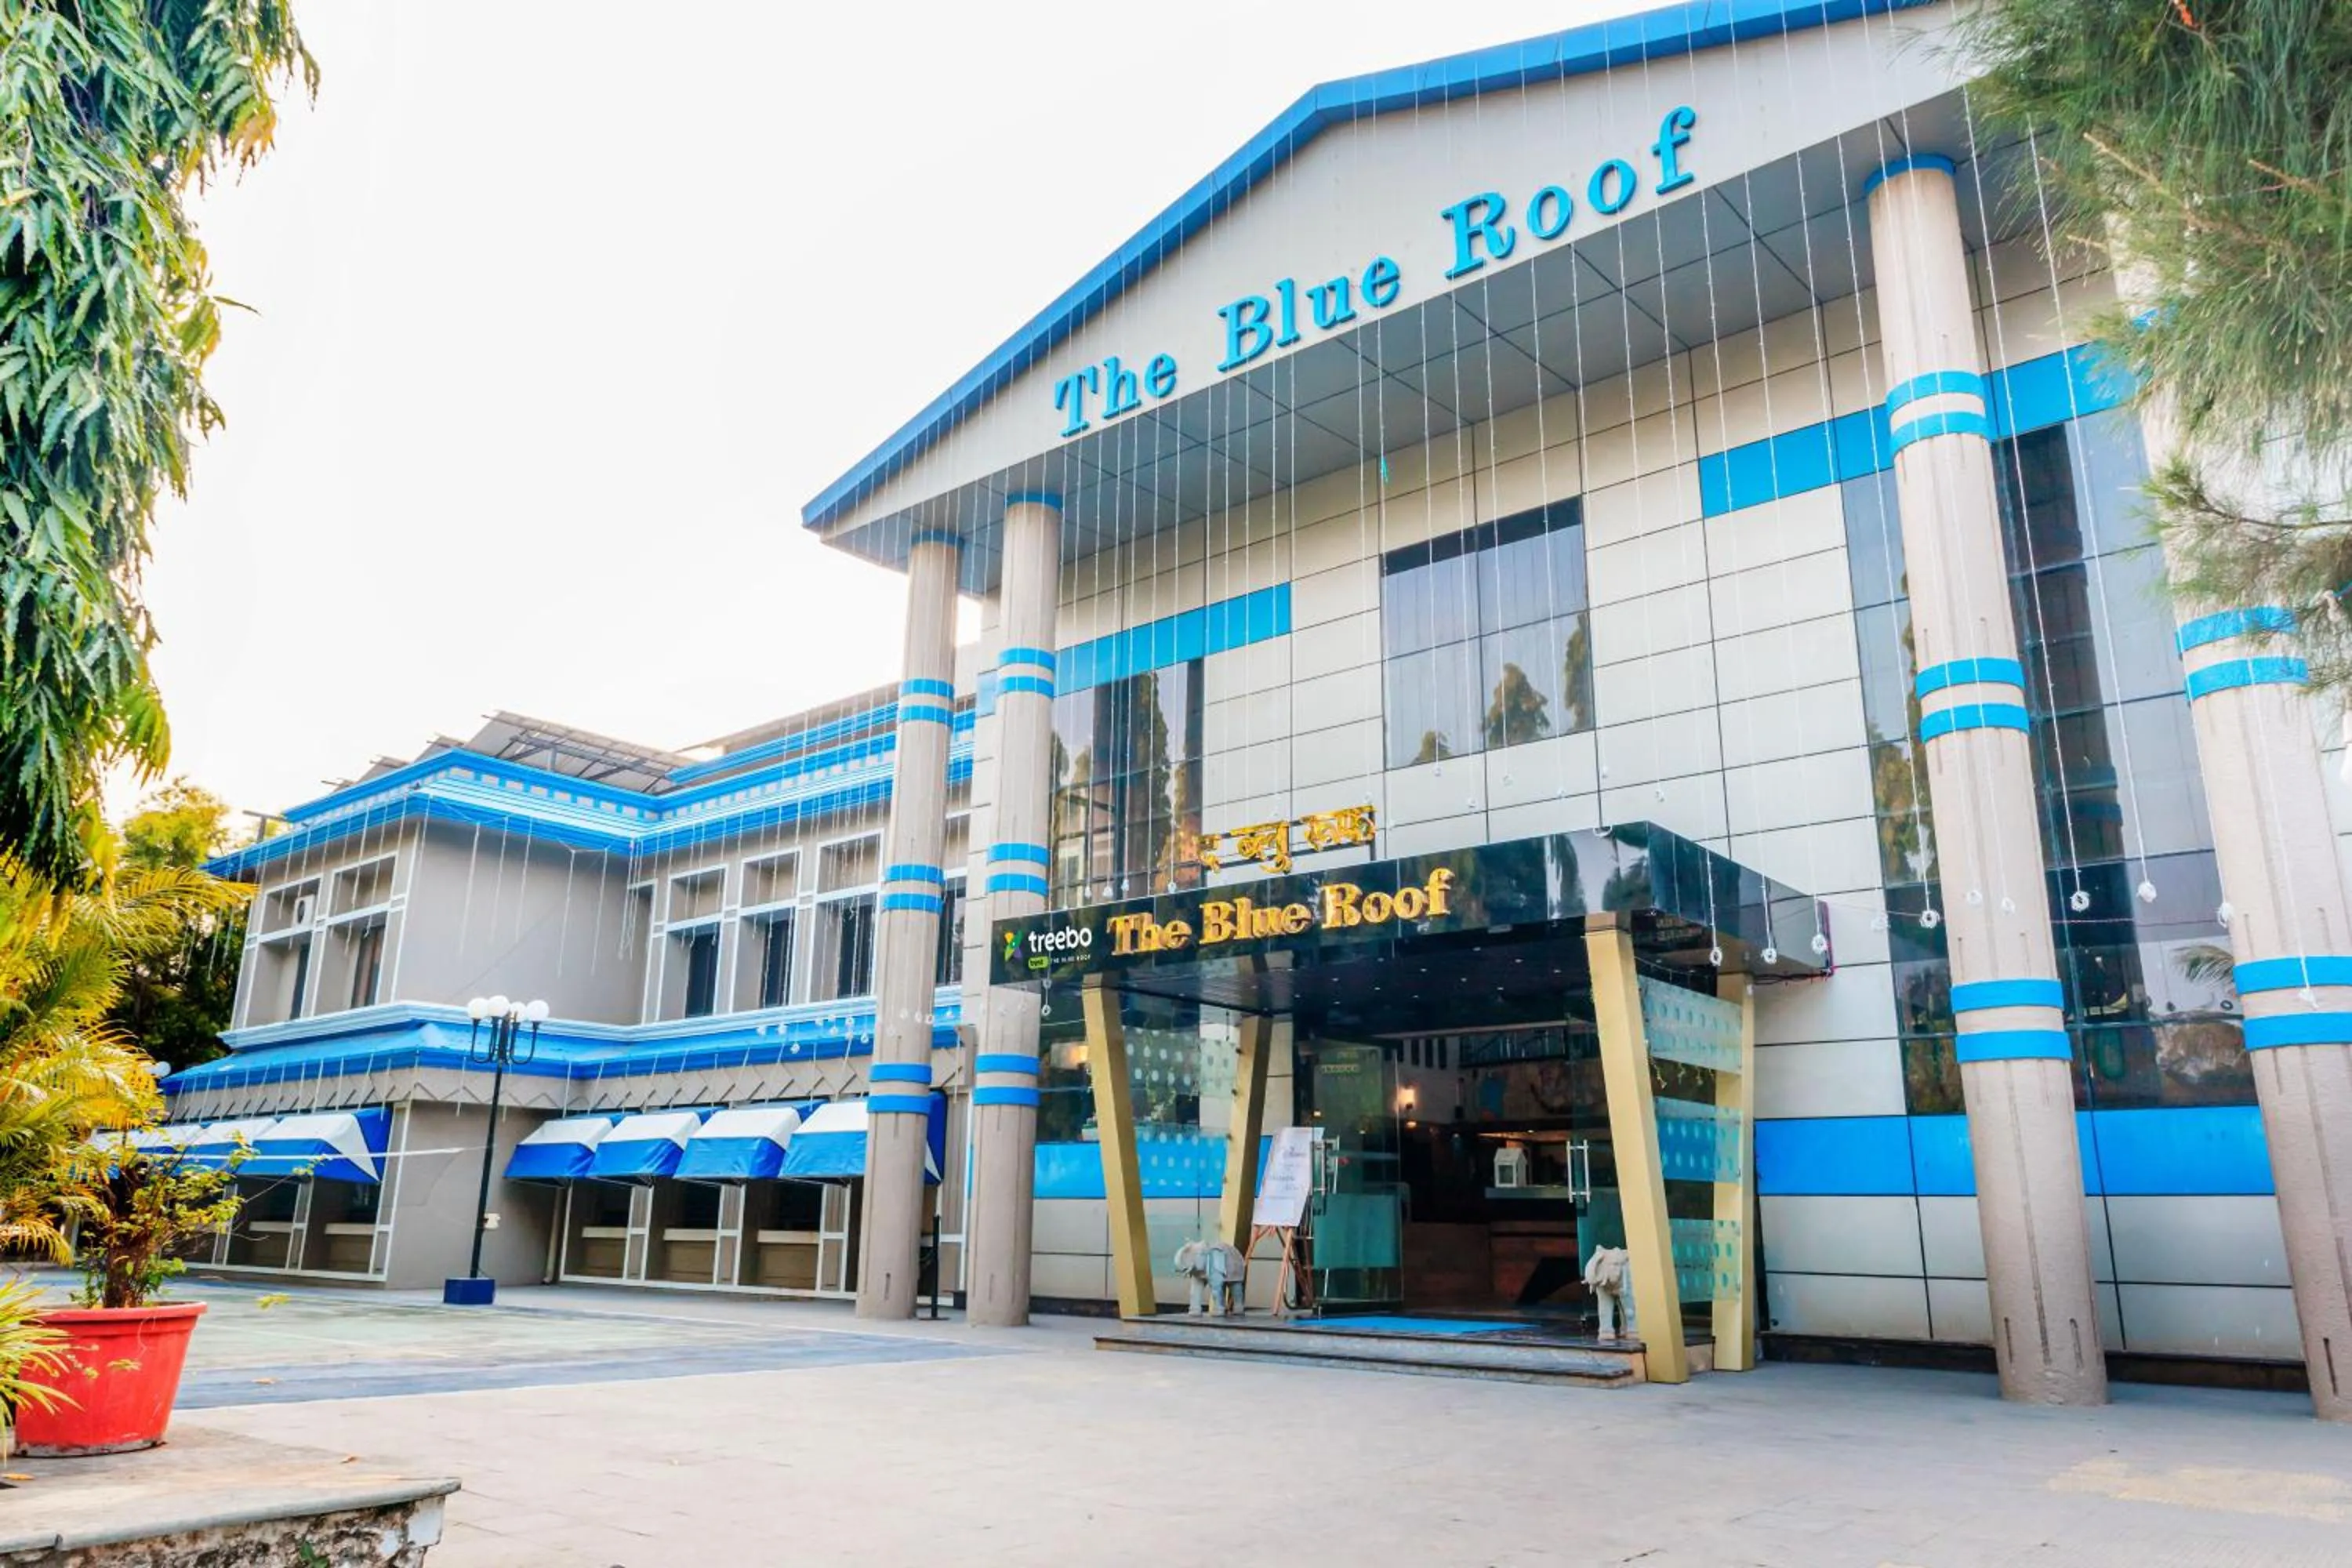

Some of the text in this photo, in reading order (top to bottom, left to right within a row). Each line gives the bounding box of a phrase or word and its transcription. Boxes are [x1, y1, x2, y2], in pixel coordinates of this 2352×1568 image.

[1054, 105, 1697, 438] The Blue Roof
[1028, 925, 1092, 953] treebo
[1107, 867, 1456, 956] The Blue Roof
